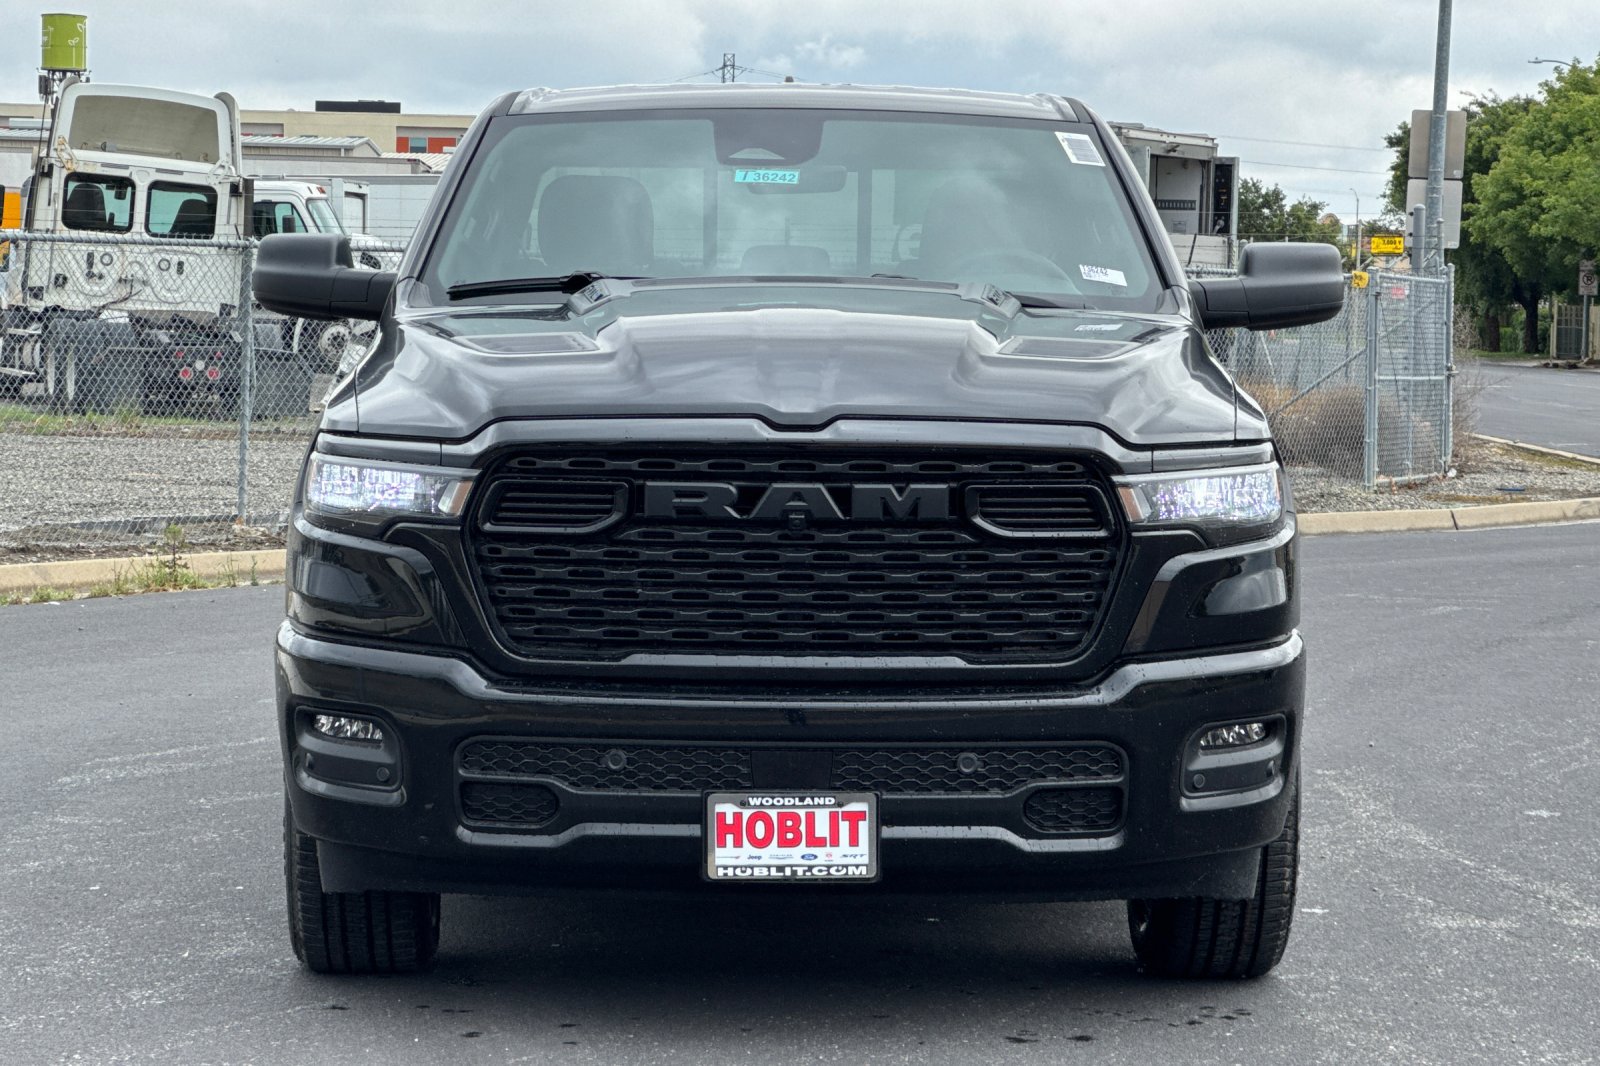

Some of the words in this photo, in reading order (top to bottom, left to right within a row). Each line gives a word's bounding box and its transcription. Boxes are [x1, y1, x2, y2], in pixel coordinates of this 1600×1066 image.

[644, 481, 950, 520] RAM
[749, 797, 835, 805] WOODLAND
[716, 810, 867, 849] HOBLIT
[717, 866, 866, 876] HOBLIT.COM
